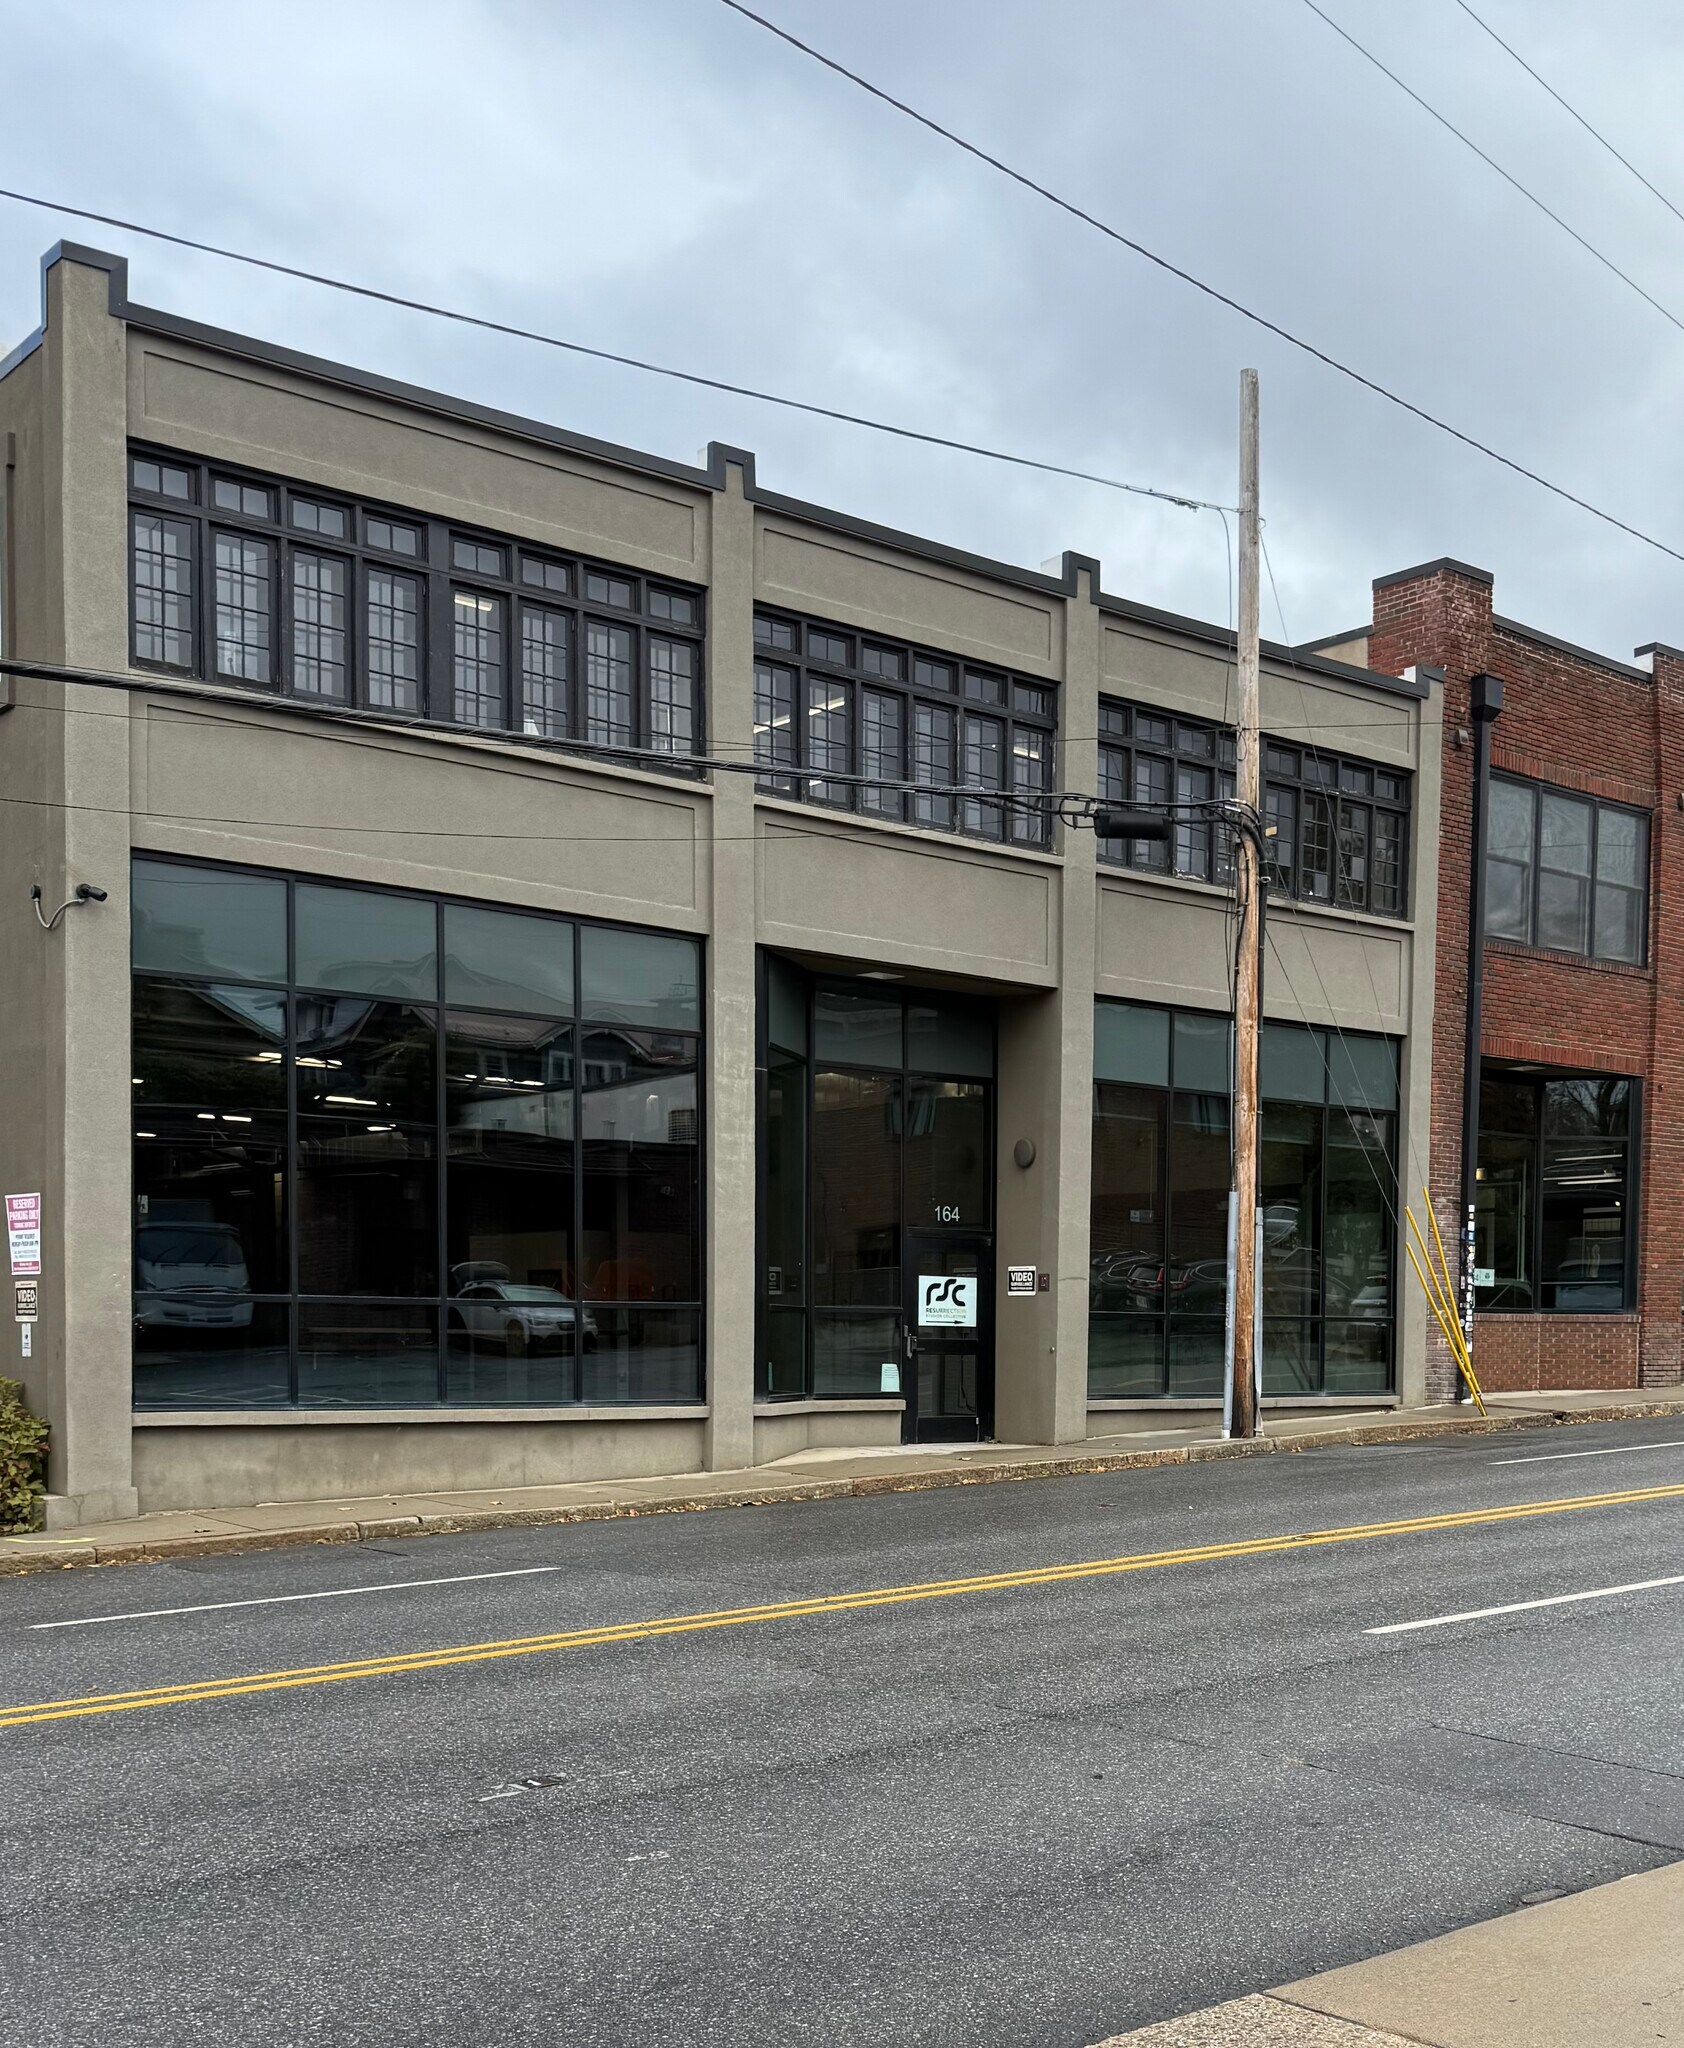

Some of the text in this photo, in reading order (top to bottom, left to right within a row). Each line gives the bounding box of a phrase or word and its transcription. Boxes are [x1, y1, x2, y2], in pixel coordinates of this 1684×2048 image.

[934, 1205, 960, 1222] 164
[1010, 1272, 1033, 1282] VIDEO
[17, 1289, 35, 1302] VIDEO
